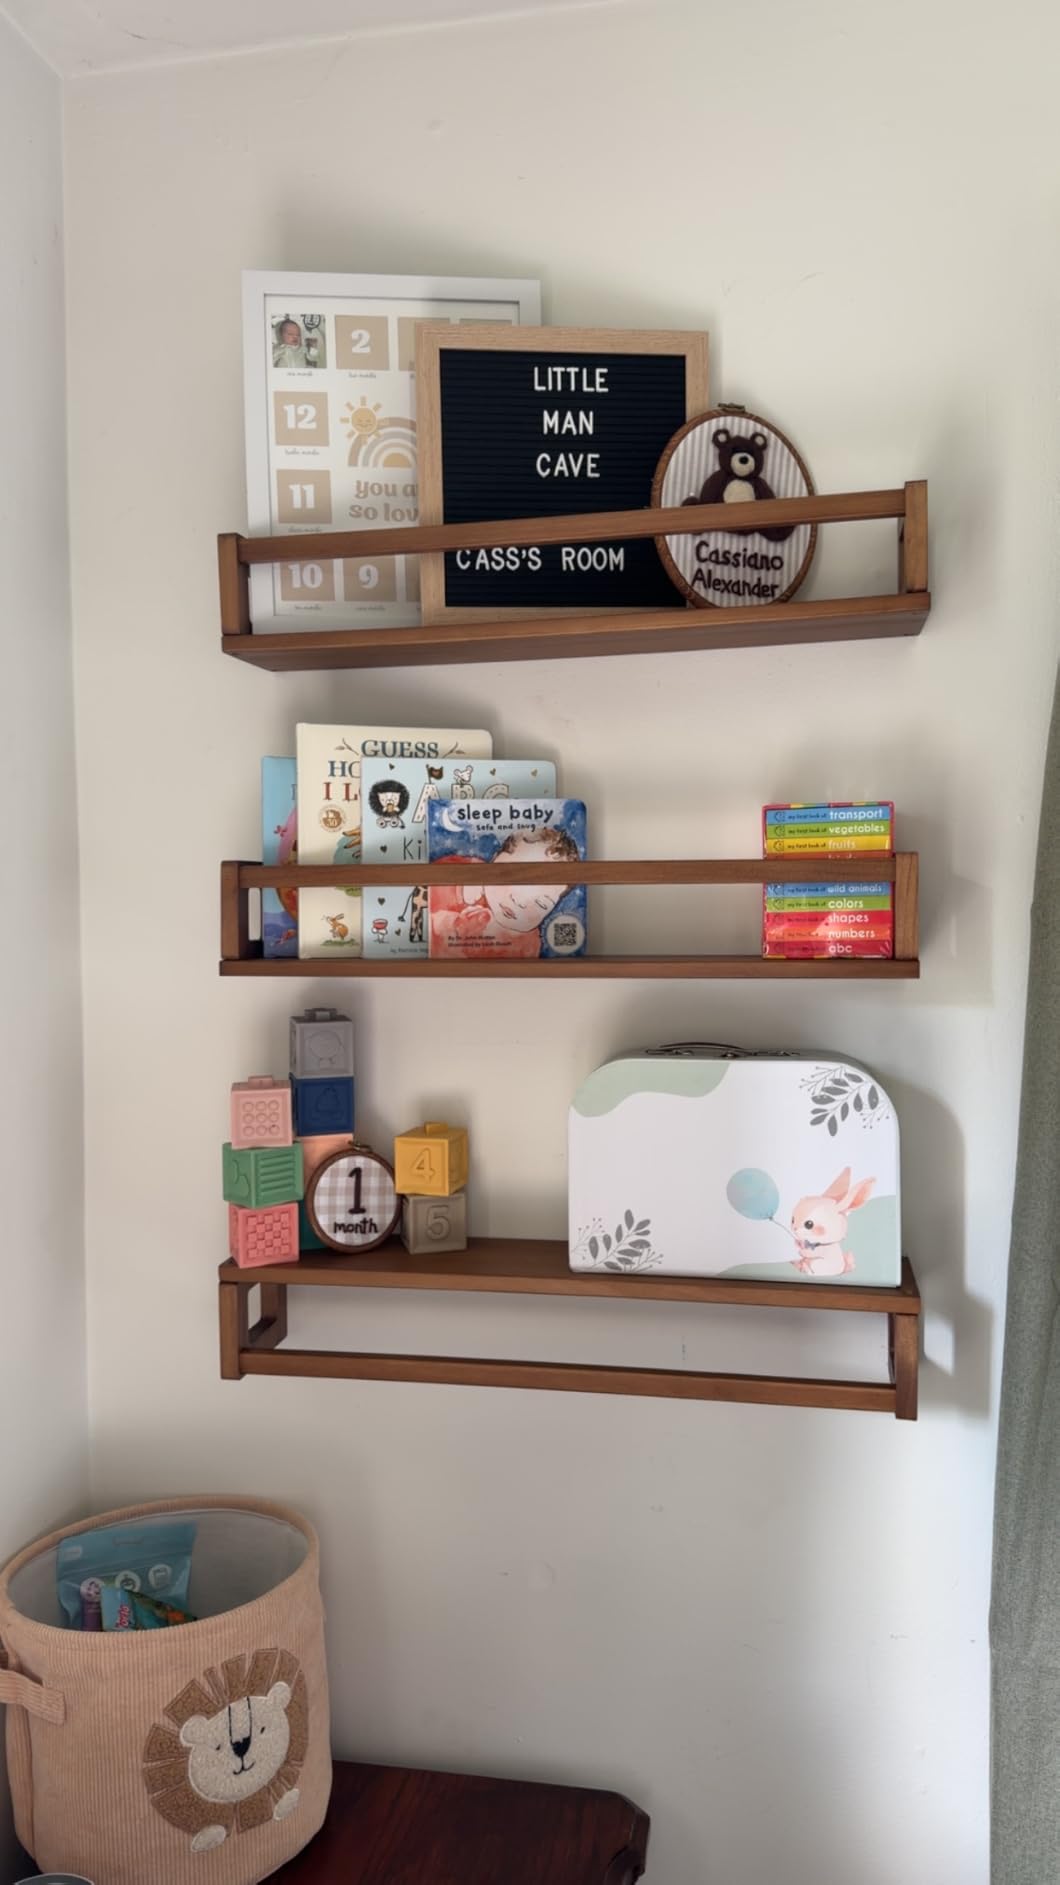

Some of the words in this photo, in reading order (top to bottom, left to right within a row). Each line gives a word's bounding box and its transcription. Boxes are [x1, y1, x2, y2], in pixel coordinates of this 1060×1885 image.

[351, 329, 371, 353] 2
[533, 366, 609, 392] LITTLE
[283, 404, 317, 429] 12
[543, 410, 594, 435] MAN
[536, 453, 600, 478] CAVE
[288, 483, 315, 509] 11
[355, 479, 397, 499] you
[349, 504, 378, 521] so
[456, 546, 542, 571] CASS'S
[561, 547, 625, 572] ROOM
[695, 540, 784, 571] Cassiano
[288, 563, 323, 589] 10
[358, 564, 379, 589] 9
[691, 568, 779, 598] Alexander
[361, 739, 439, 758] GUESS
[323, 782, 332, 800] I
[457, 804, 502, 824] sleep
[509, 804, 553, 823] baby
[829, 809, 883, 821] transport
[498, 823, 513, 831] and
[828, 824, 885, 836] vegetables
[828, 840, 856, 850] fruits
[827, 884, 846, 893] wild
[848, 884, 882, 893] animals
[828, 898, 864, 909] colors
[827, 913, 869, 924] shapes
[828, 928, 875, 938] numbers
[828, 943, 852, 954] abc
[409, 1147, 435, 1181] 4
[348, 1167, 366, 1214] 1
[333, 1217, 378, 1234] month
[426, 1205, 449, 1240] 5
